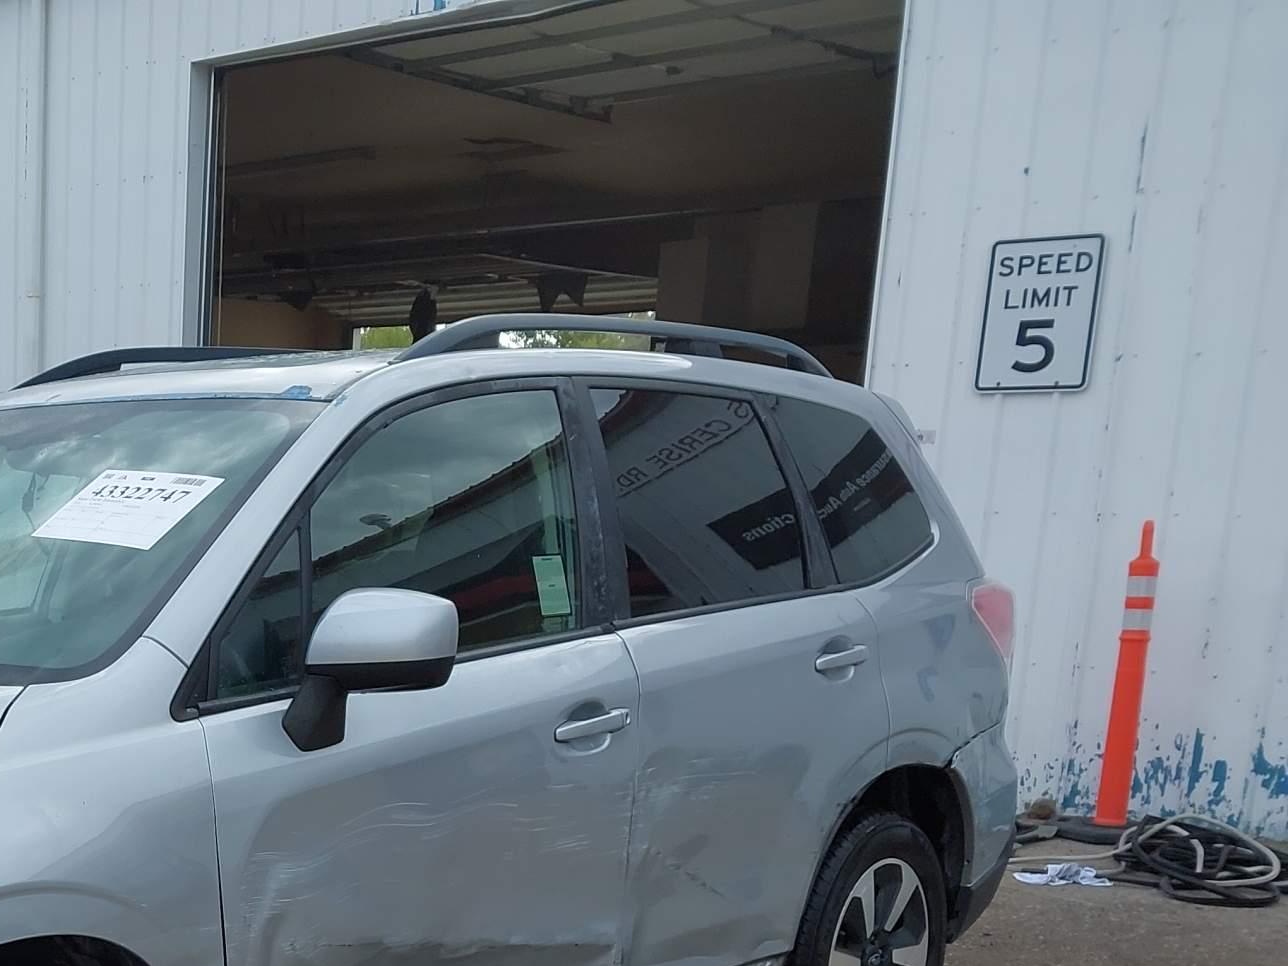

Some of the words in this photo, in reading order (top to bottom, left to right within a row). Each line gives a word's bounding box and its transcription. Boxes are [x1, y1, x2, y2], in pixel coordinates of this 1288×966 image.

[999, 251, 1093, 277] SPEED
[1004, 285, 1079, 309] LIMIT
[1011, 318, 1055, 373] 5
[92, 485, 192, 504] 43322747
